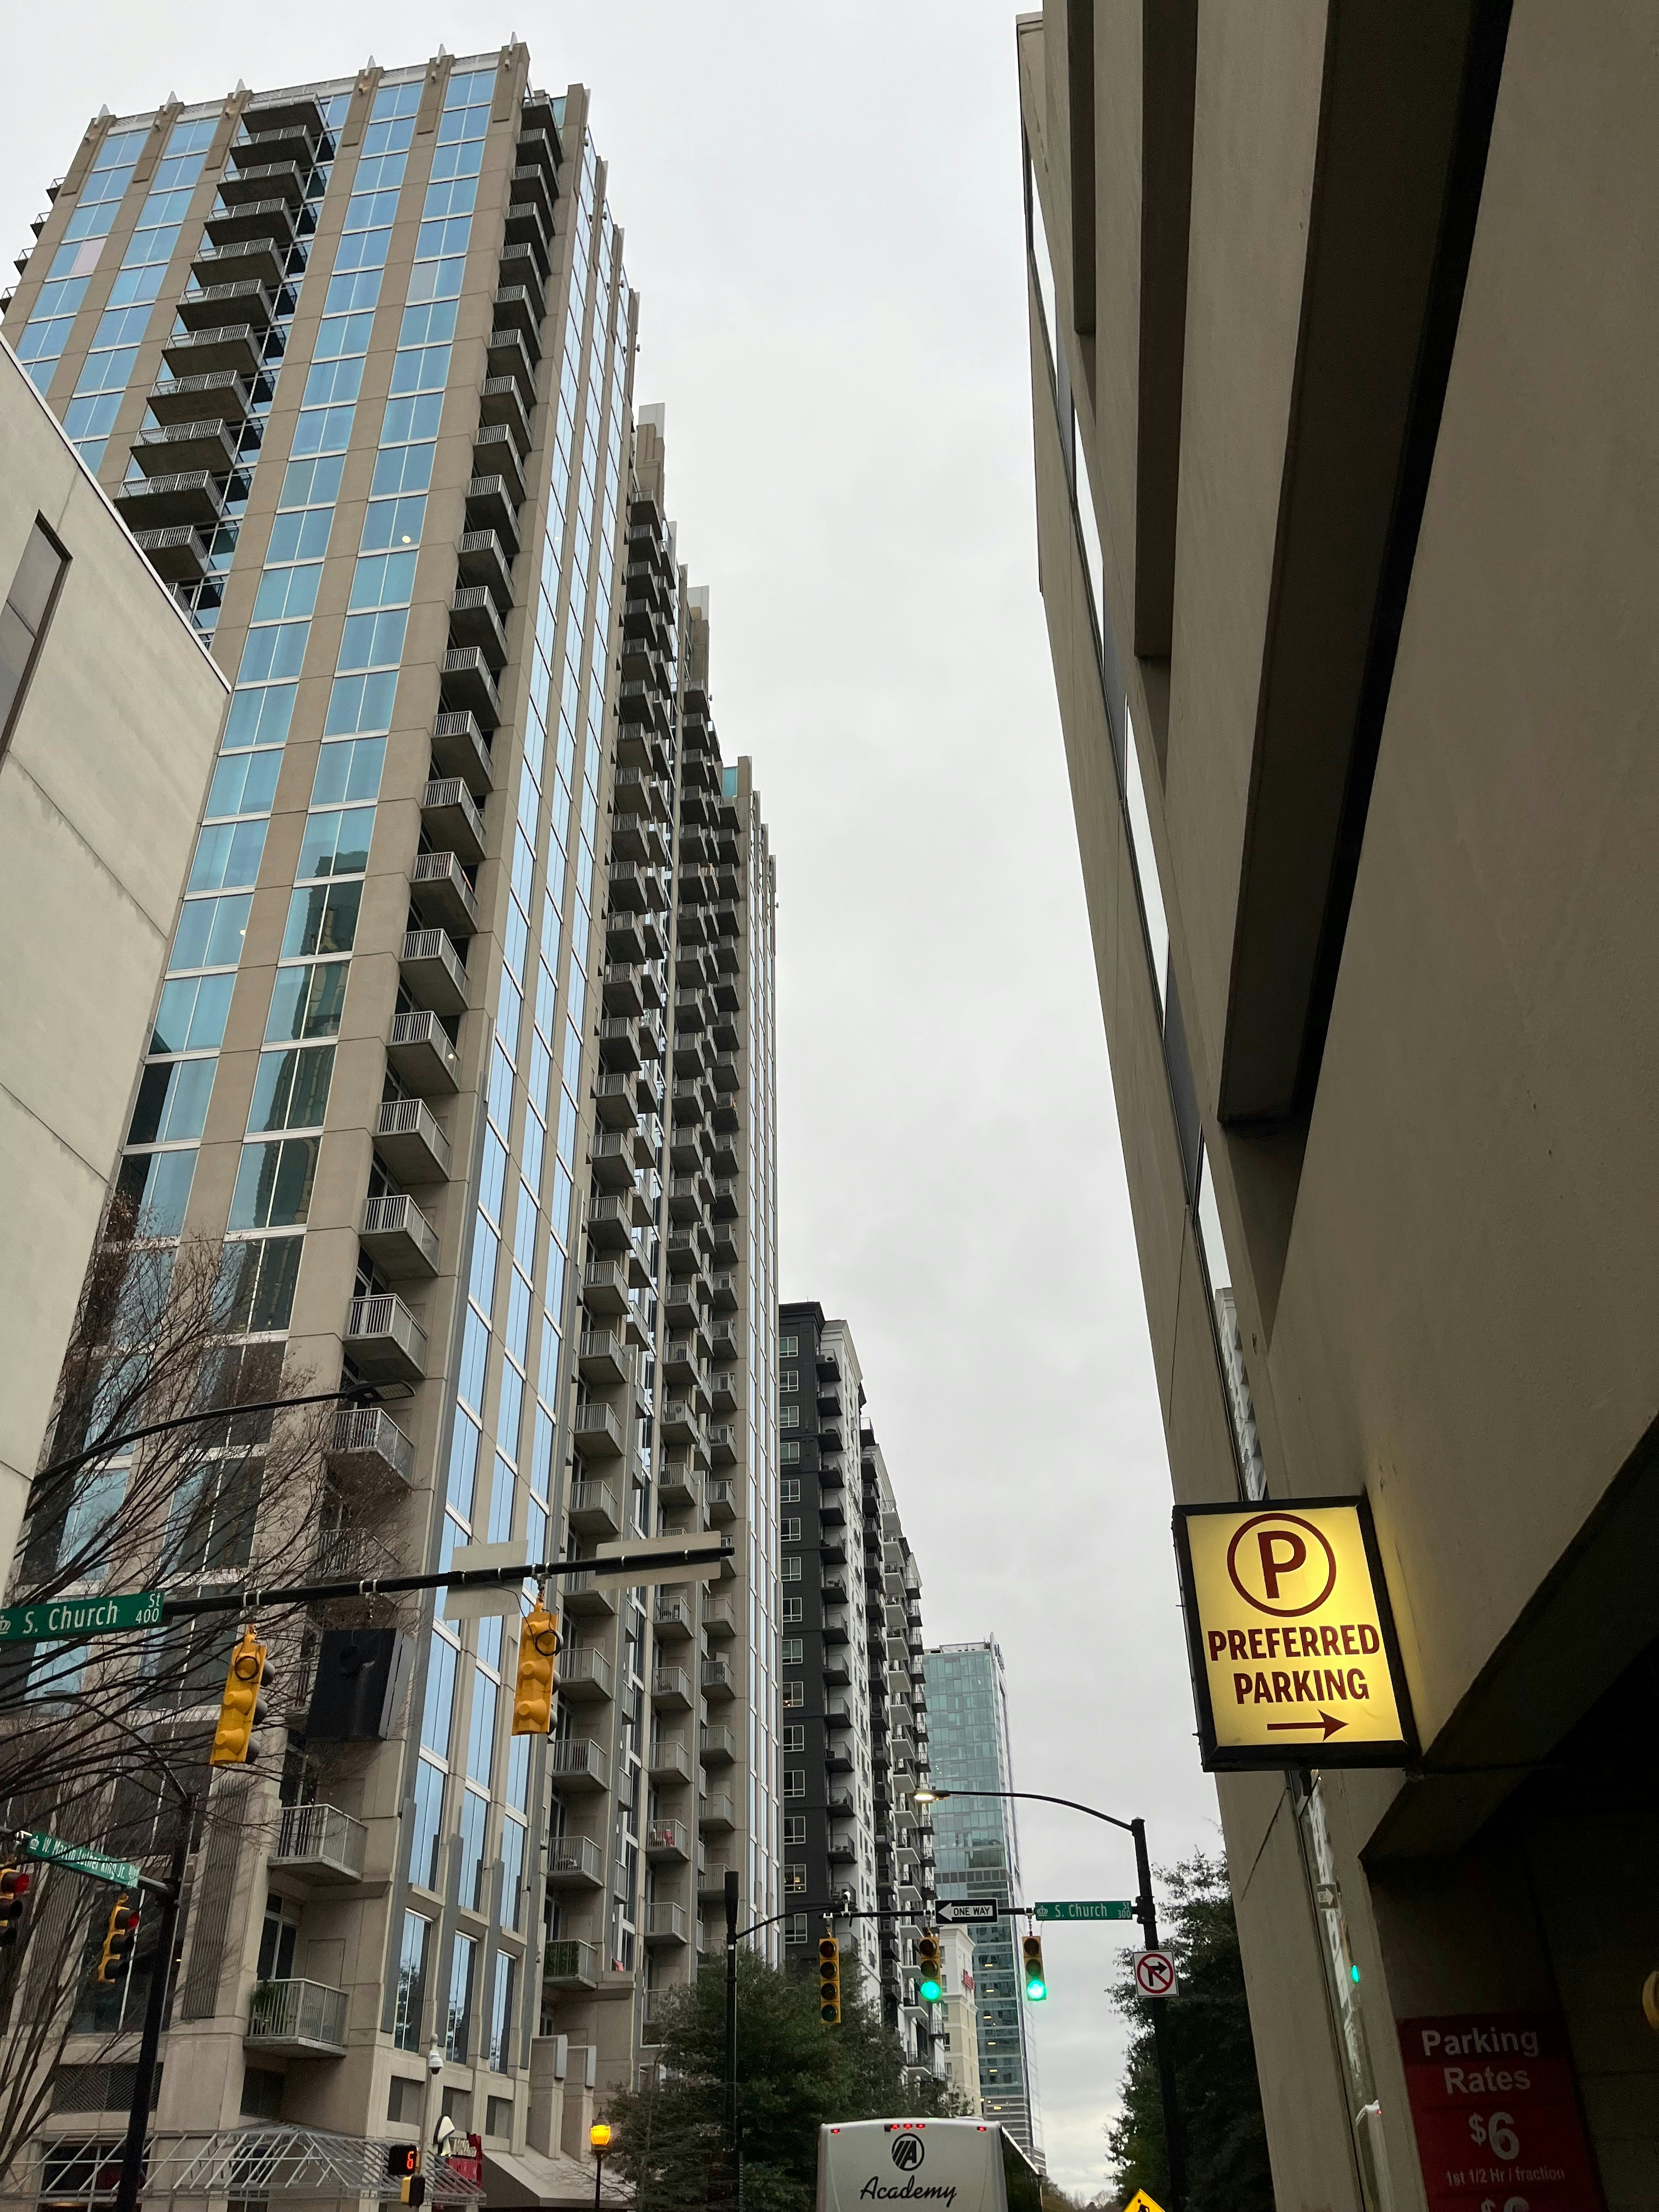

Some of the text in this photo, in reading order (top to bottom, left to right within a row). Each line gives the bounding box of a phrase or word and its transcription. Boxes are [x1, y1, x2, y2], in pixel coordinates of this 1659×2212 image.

[1257, 1530, 1307, 1599] P
[22, 1592, 161, 1634] S. Church St
[135, 1608, 160, 1624] 400
[1207, 1624, 1380, 1662] PREFERRED
[1233, 1668, 1370, 1705] PARKING
[42, 1836, 52, 1853] W.
[117, 1863, 126, 1879] Jr.
[953, 1906, 991, 1916] ONE WAY
[1054, 1901, 1130, 1918] S. Church St
[1117, 1910, 1131, 1919] 300
[1421, 2026, 1539, 2057] Parking
[1443, 2066, 1531, 2095] Rates
[1468, 2112, 1520, 2160] $6
[860, 2175, 957, 2208] Academy
[1446, 2169, 1466, 2186] 1st
[1468, 2168, 1488, 2185] 1/2
[1489, 2168, 1505, 2183] Hr
[1515, 2166, 1565, 2182] fraction
